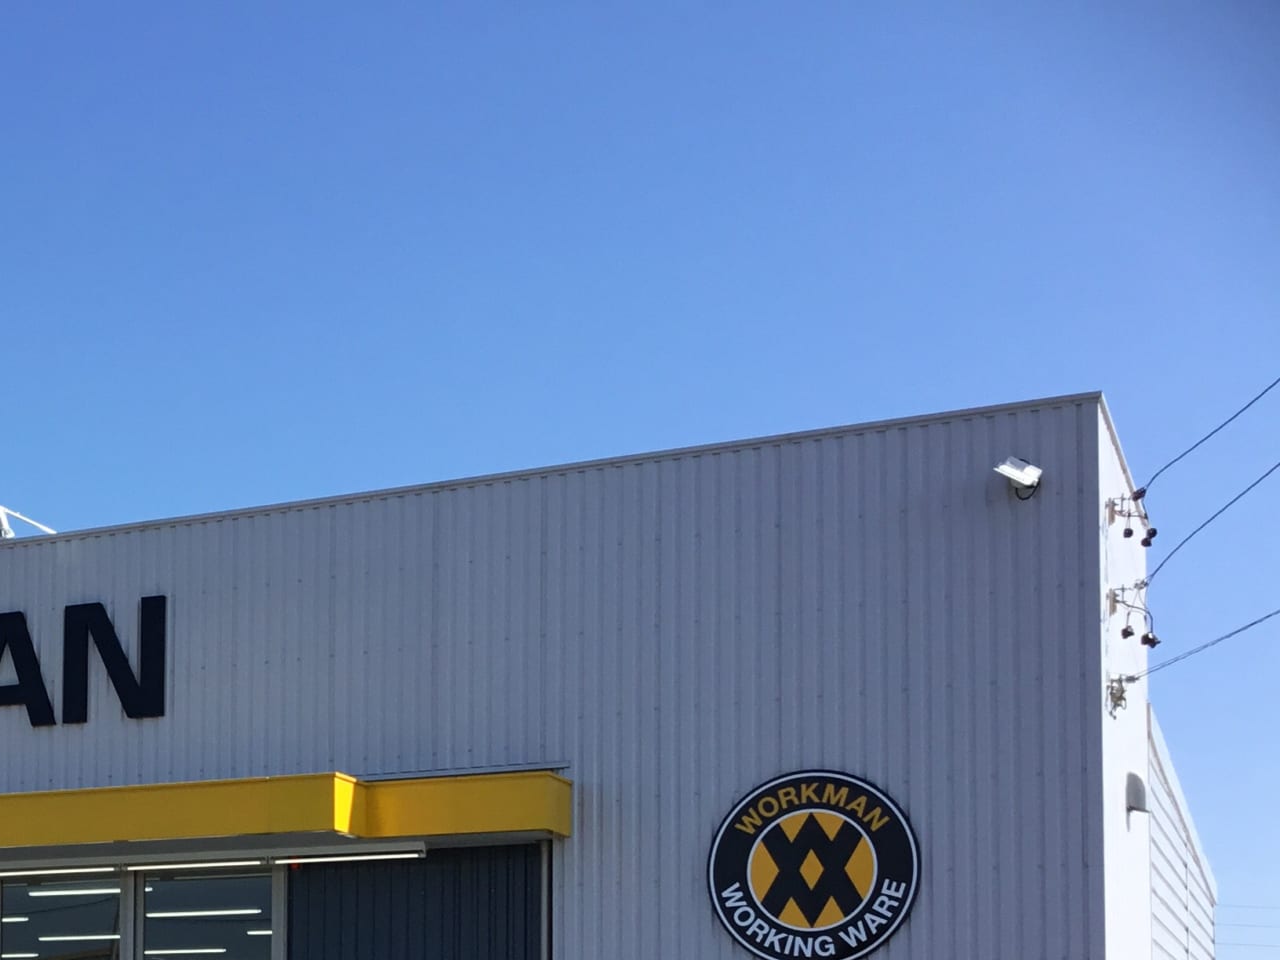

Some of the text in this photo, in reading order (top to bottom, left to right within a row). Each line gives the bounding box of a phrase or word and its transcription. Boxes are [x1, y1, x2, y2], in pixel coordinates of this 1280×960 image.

[734, 782, 891, 836] WORKMAN
[721, 878, 907, 958] WORKING WARE
